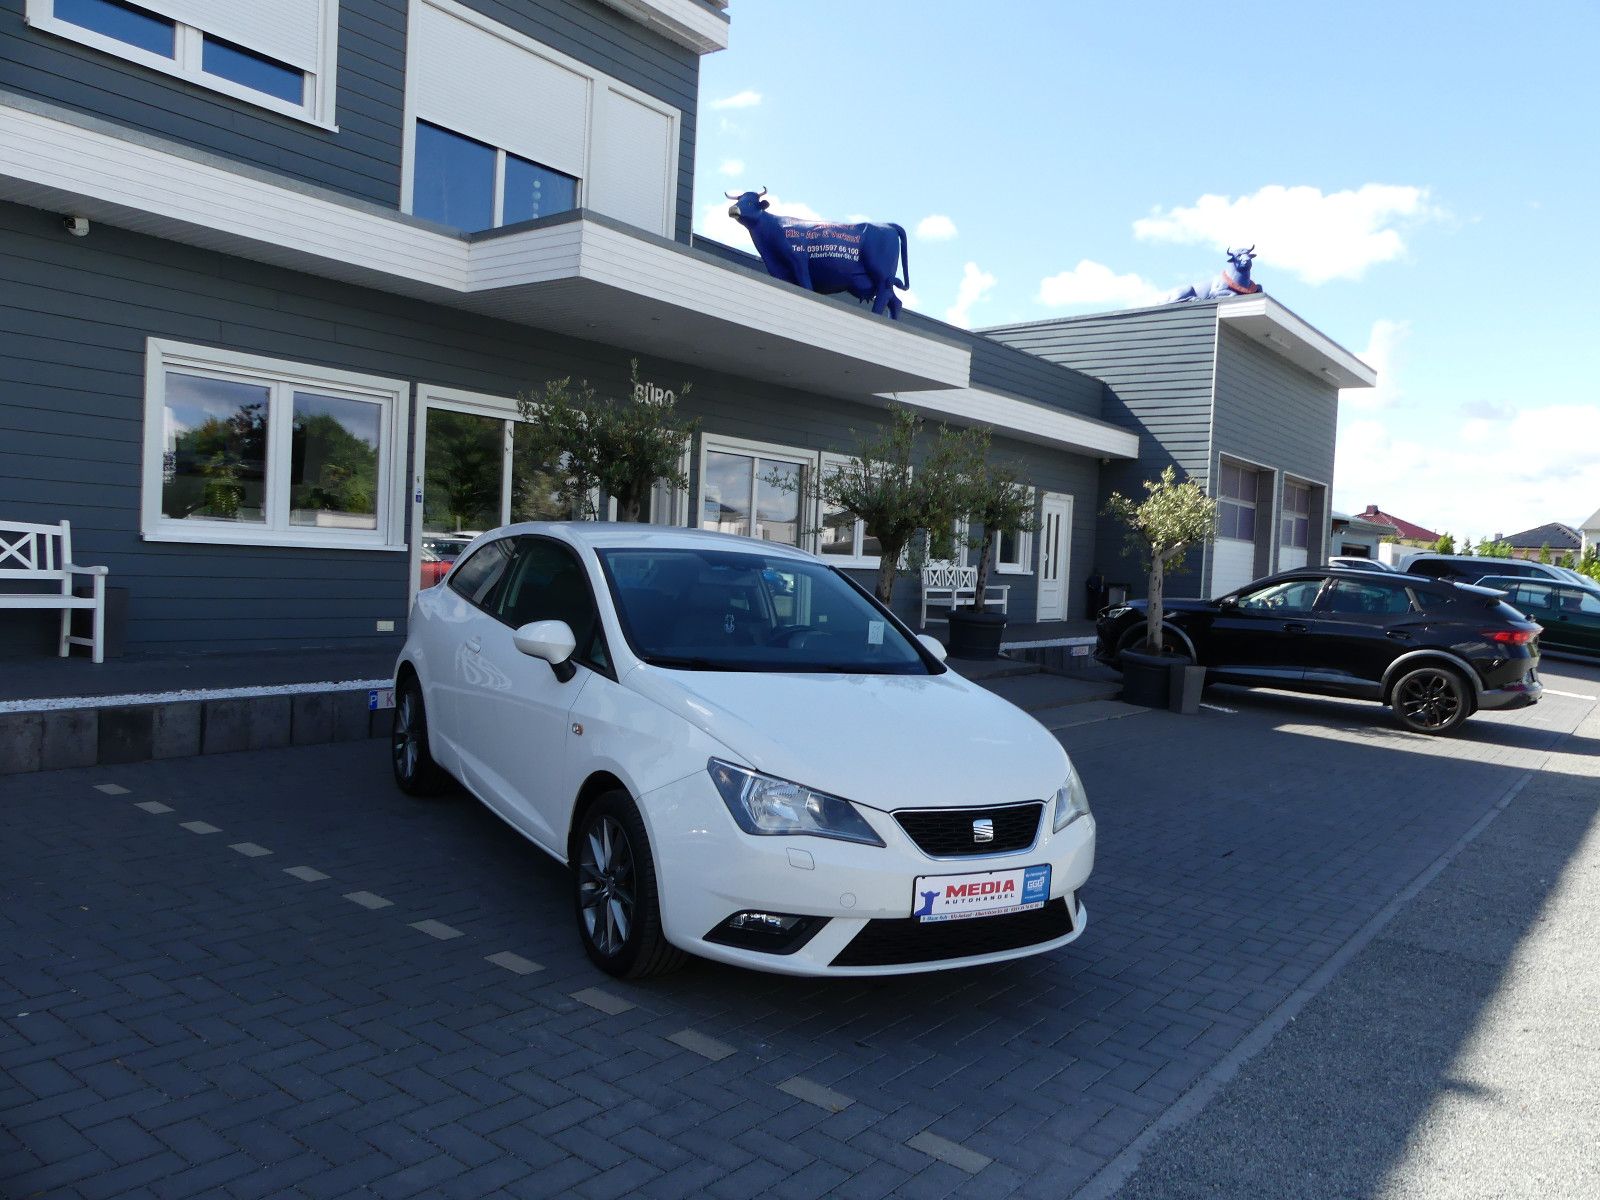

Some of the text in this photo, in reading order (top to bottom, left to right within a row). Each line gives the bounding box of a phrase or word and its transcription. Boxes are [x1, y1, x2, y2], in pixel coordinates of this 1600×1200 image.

[848, 247, 859, 256] 100
[634, 382, 675, 407] BÜRO
[946, 879, 1015, 898] MEDIA
[945, 894, 1015, 904] AUTOHANDEL
